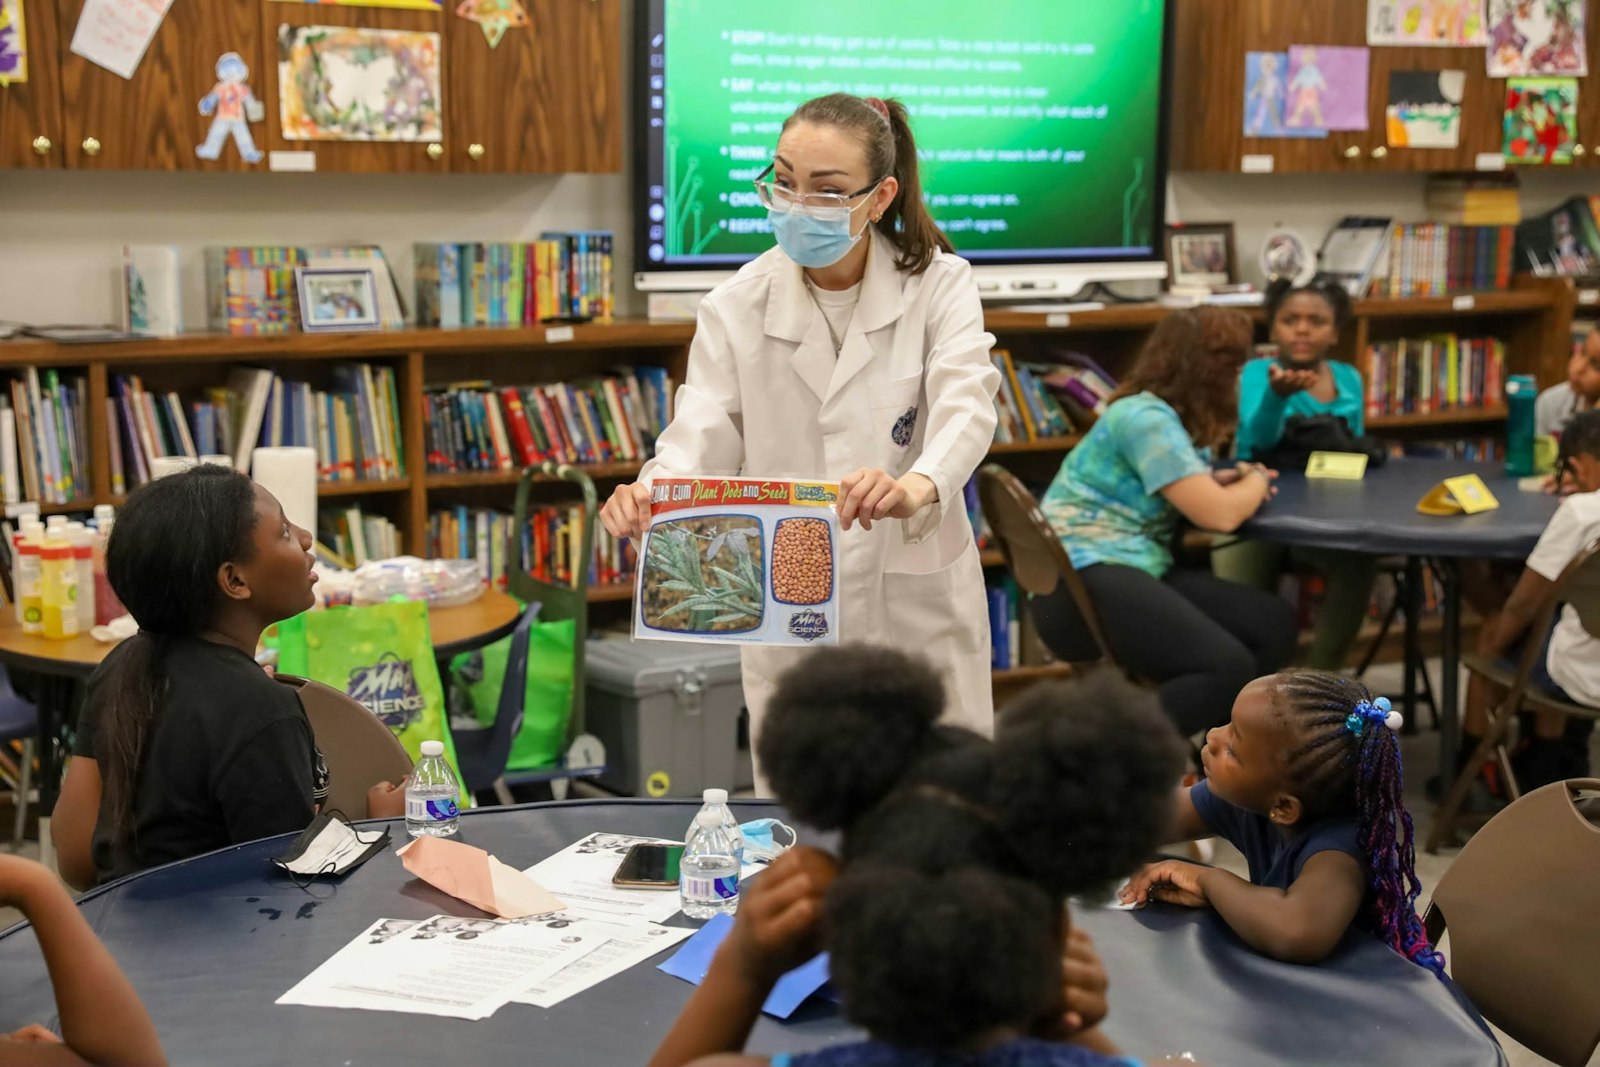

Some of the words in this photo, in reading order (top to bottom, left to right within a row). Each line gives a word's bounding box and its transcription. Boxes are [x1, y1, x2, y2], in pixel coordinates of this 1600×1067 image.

[1095, 103, 1109, 119] of
[1049, 147, 1063, 162] of
[931, 194, 950, 208] you
[950, 195, 970, 206] can
[971, 194, 1002, 208] agree
[672, 484, 691, 501] GUM
[691, 479, 719, 507] Plant
[720, 480, 742, 503] Pods
[742, 485, 759, 498] AND
[757, 482, 788, 501] Seeds
